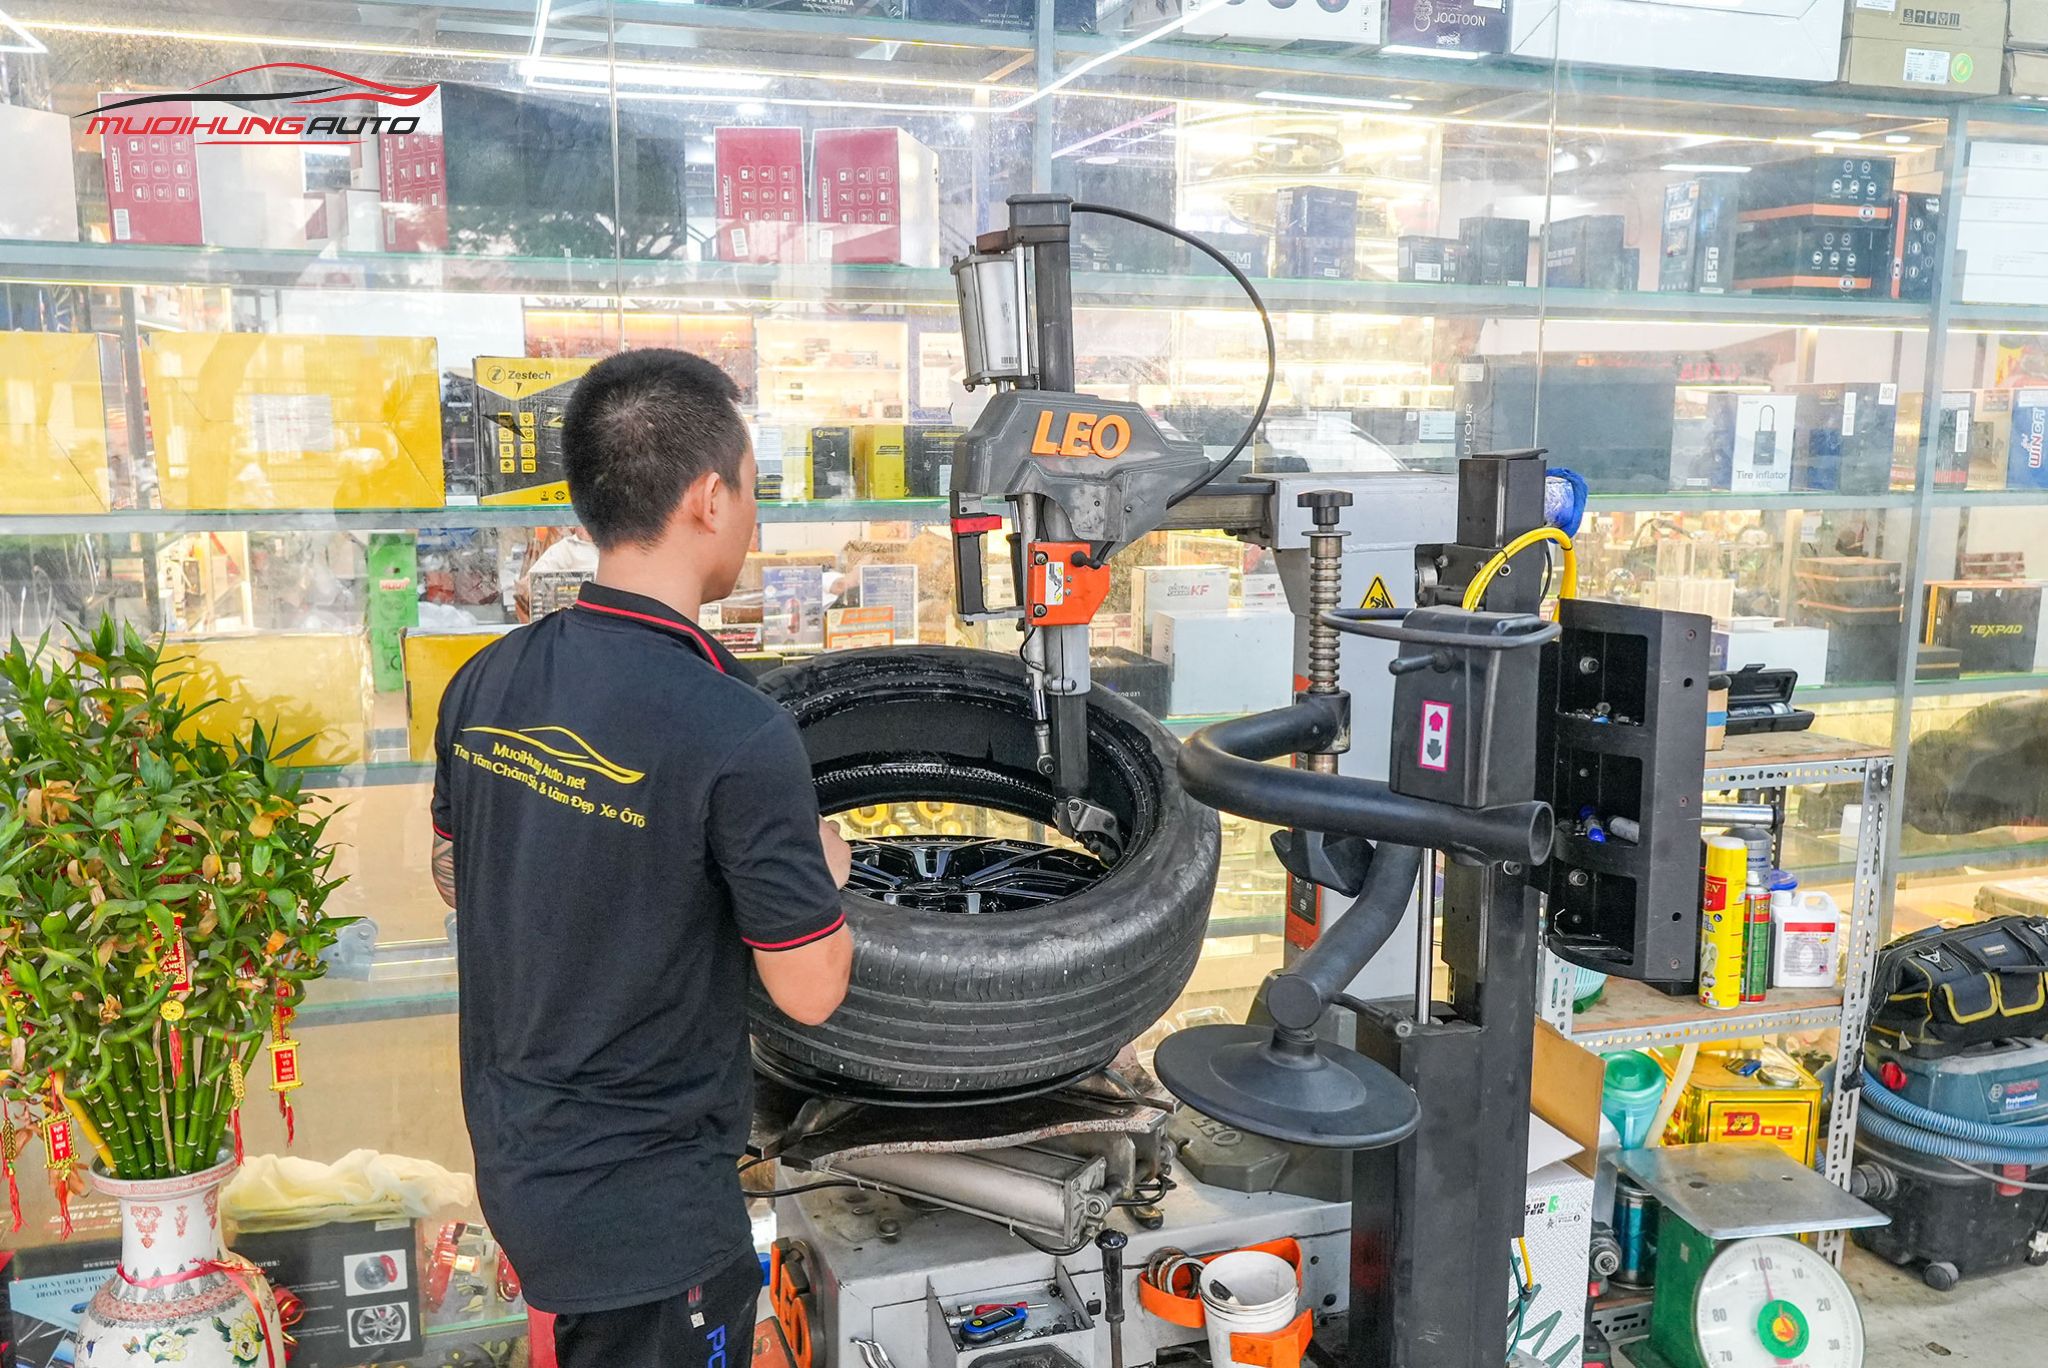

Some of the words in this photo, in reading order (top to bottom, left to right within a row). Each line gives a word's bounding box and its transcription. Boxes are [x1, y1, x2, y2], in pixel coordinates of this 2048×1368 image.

[508, 370, 551, 380] Zestech
[1031, 410, 1131, 459] LEO
[1736, 470, 1754, 480] Tire
[1755, 470, 1787, 480] inflator
[1190, 584, 1210, 596] KF
[539, 784, 547, 795] &
[599, 803, 618, 819] Xe
[1722, 1111, 1793, 1140] Dog
[1752, 1257, 1773, 1271] 100
[1792, 1268, 1804, 1279] 10
[1817, 1298, 1831, 1312] 20
[1712, 1308, 1727, 1322] 80
[1828, 1339, 1840, 1350] 30
[1720, 1351, 1733, 1362] 70
